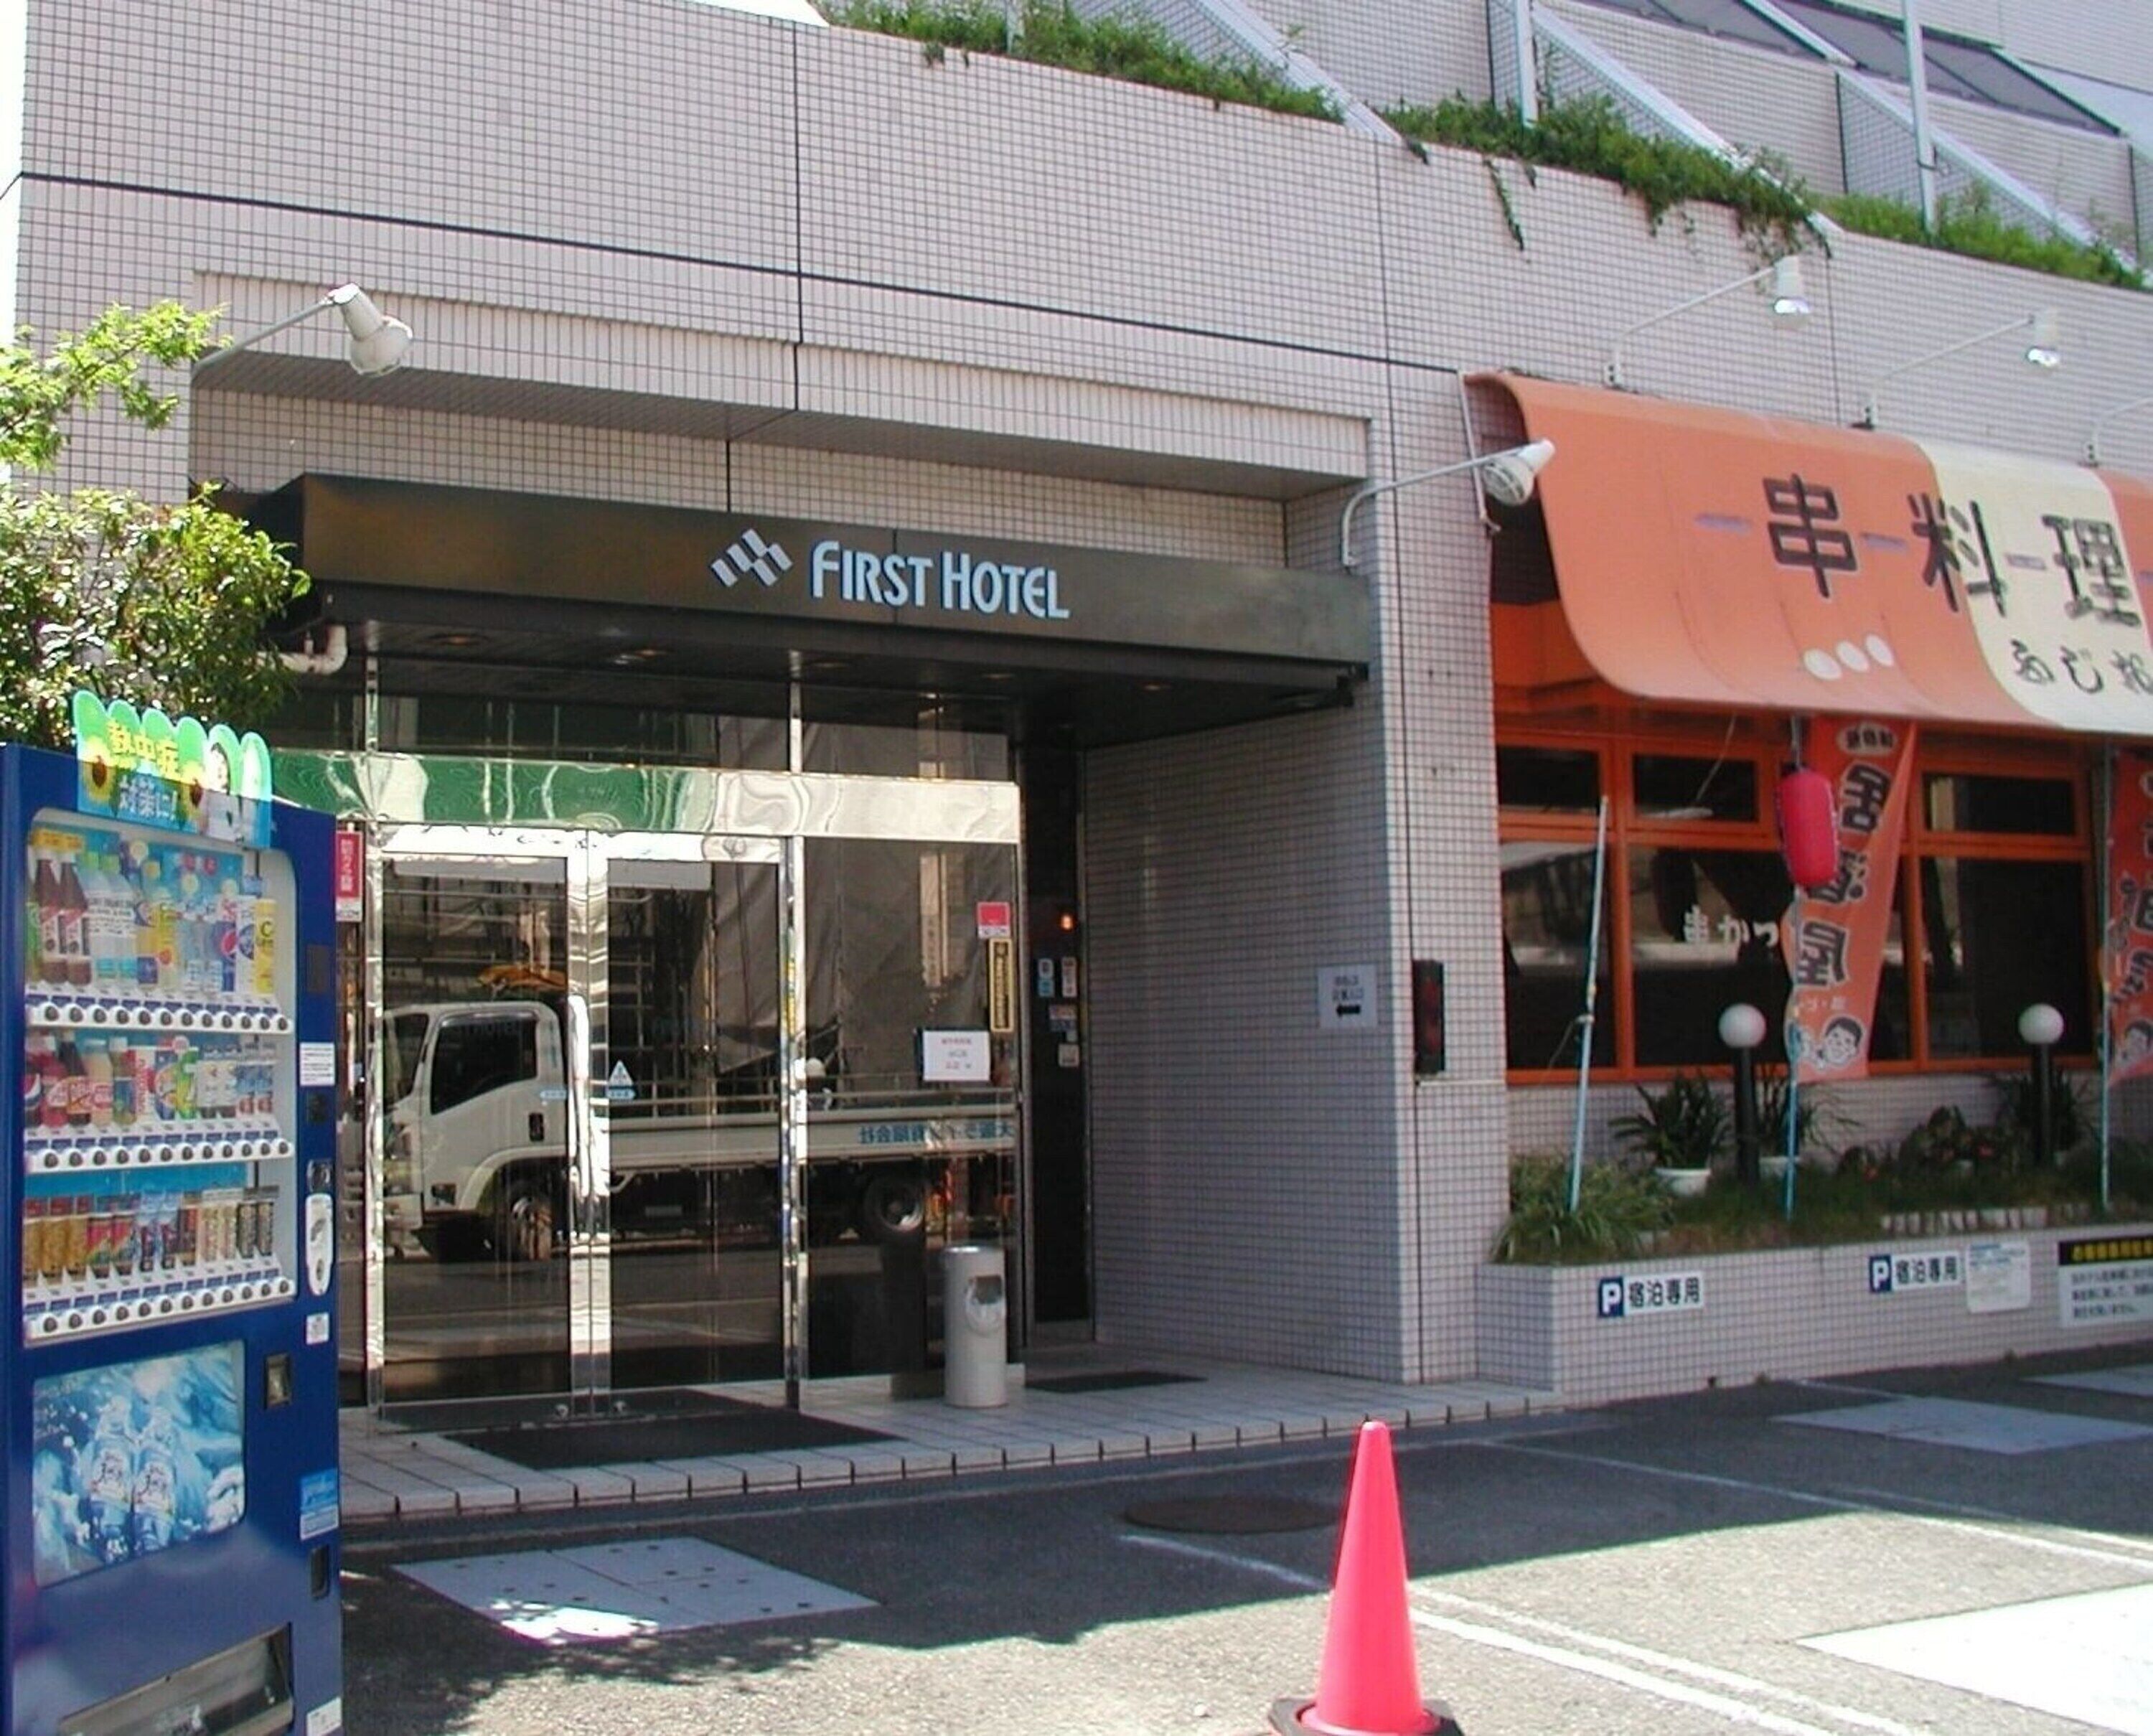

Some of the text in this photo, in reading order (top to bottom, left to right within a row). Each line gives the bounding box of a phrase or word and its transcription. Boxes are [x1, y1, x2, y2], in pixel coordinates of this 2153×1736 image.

[811, 540, 1070, 619] FIRST HOTEL
[1895, 1256, 1958, 1284] 宿泊専用
[1628, 1277, 1701, 1308] 宿泊専用
